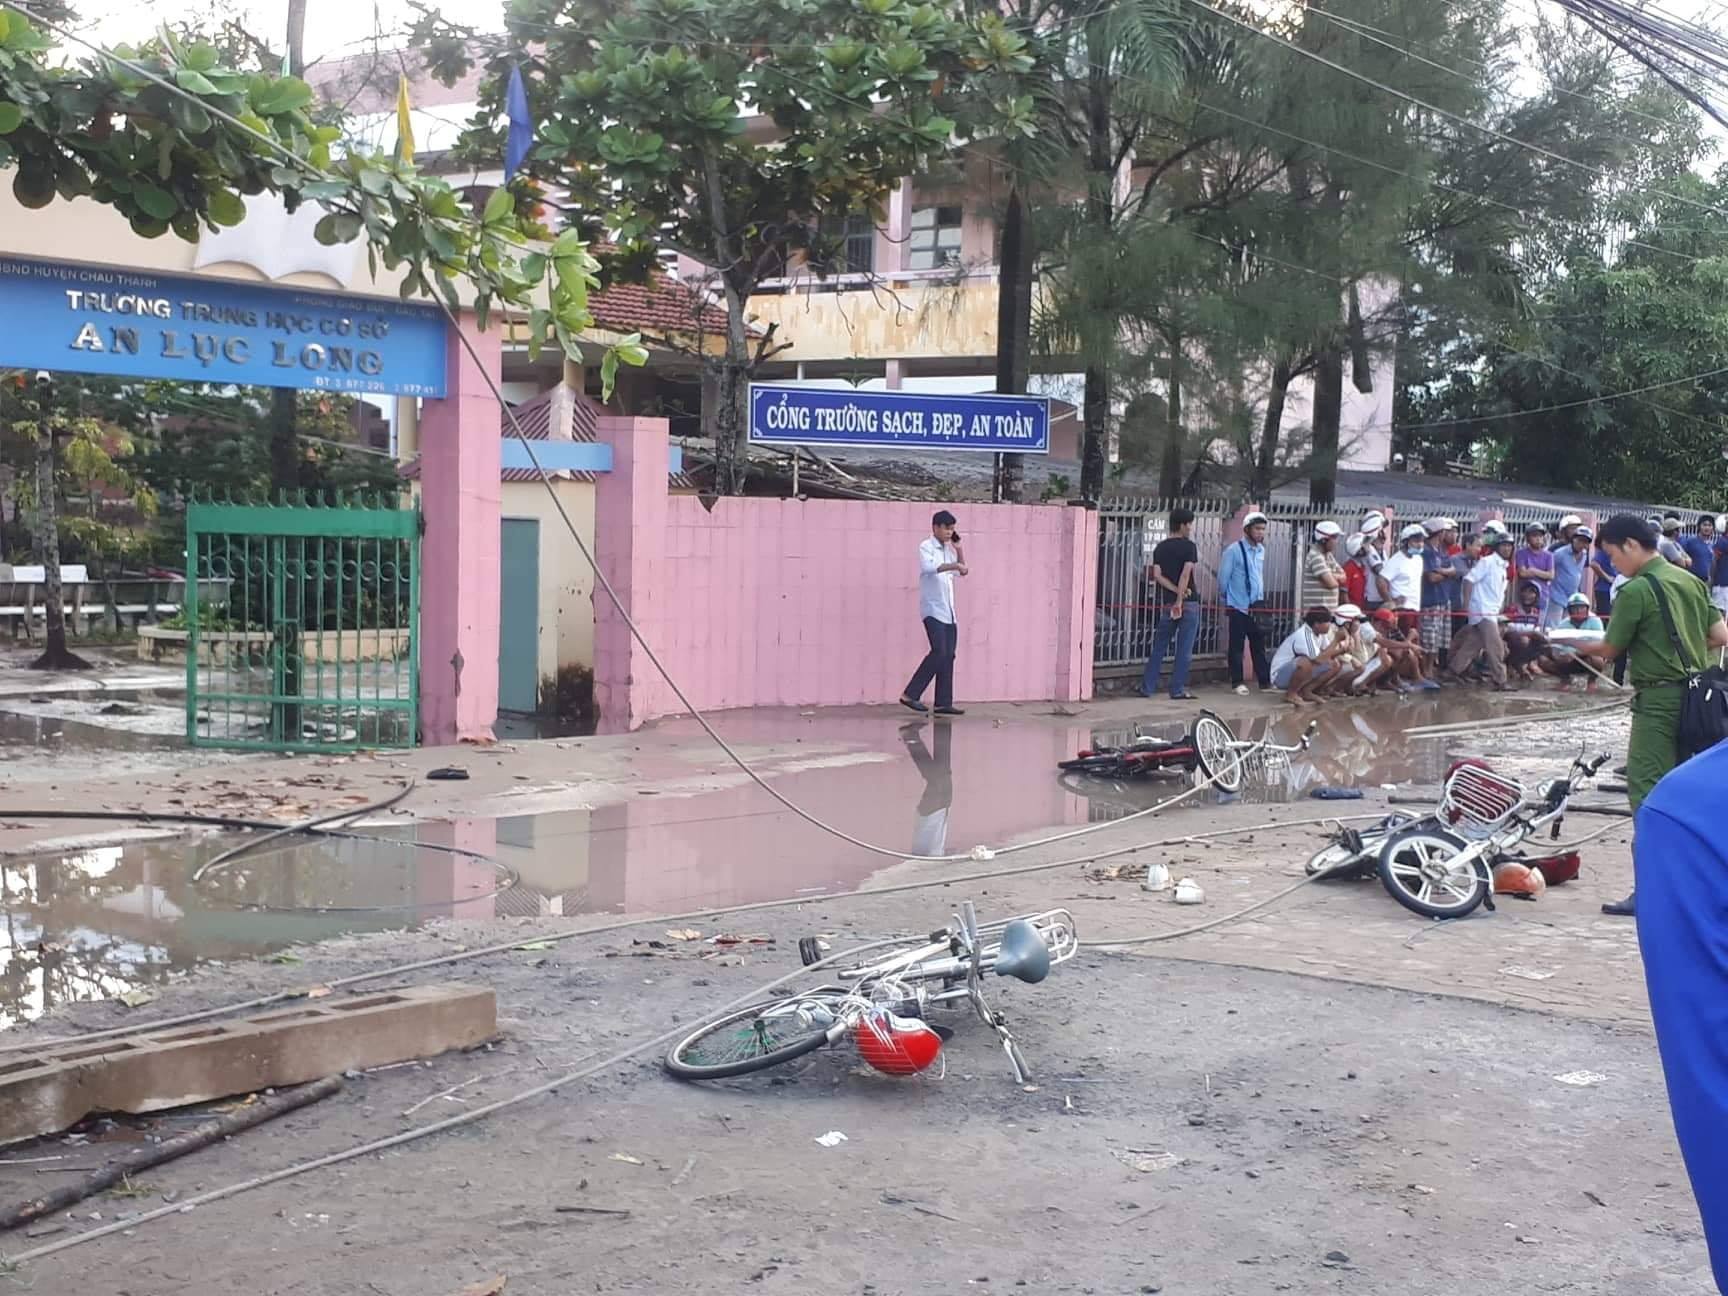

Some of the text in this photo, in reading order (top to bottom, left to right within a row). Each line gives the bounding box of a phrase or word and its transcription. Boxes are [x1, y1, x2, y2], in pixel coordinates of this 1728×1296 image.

[179, 301, 257, 329] TRUNG
[265, 311, 314, 336] HỌC
[69, 321, 384, 375] AN LỤC LONG
[766, 392, 1034, 440] CỔNG TRƯỜNG SẠCH, ĐẸP, AN TOÀN
